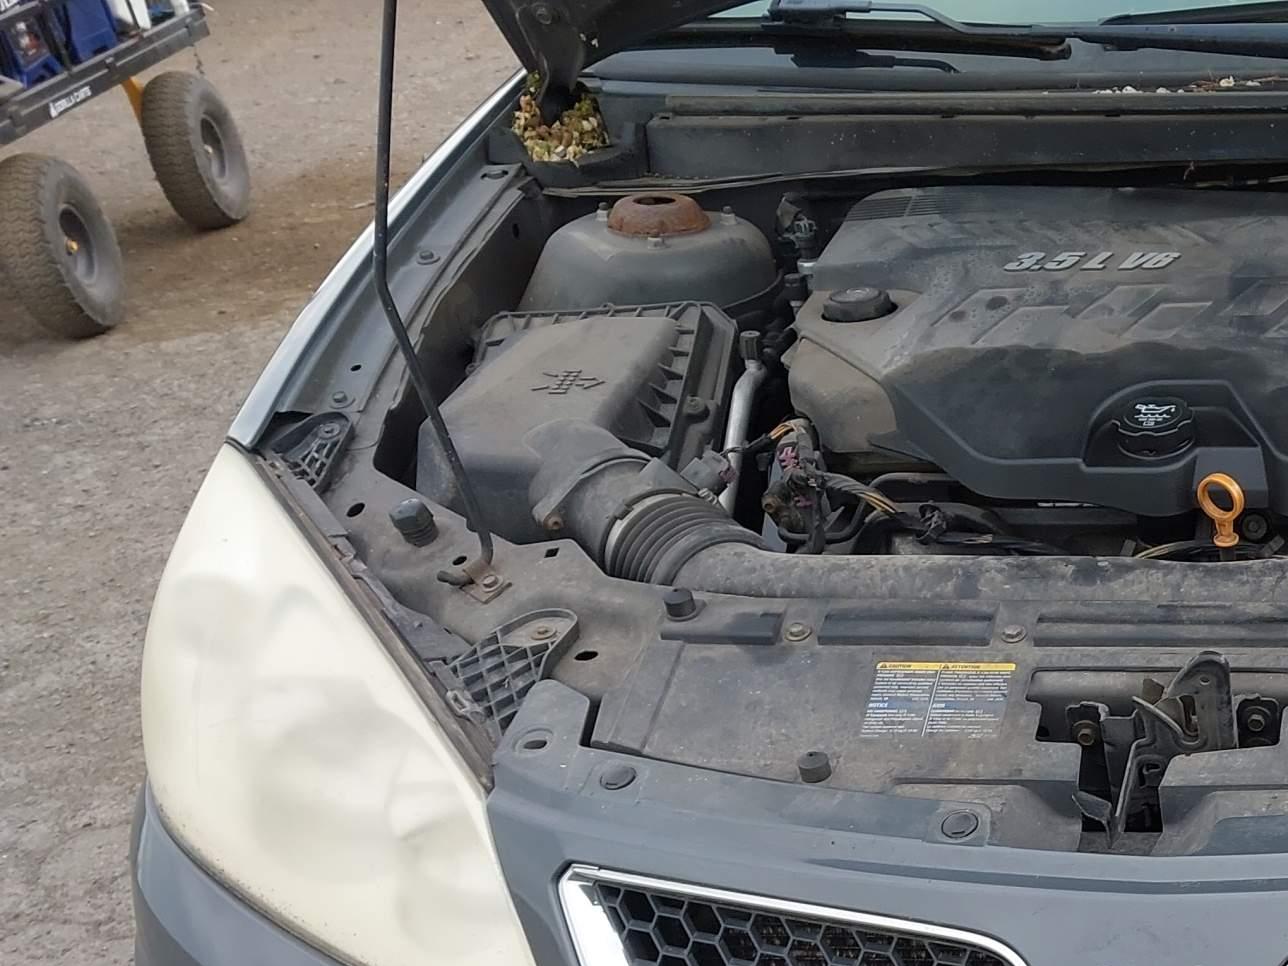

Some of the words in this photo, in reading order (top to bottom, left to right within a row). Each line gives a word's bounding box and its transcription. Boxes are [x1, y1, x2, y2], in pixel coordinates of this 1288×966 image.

[1003, 251, 1086, 272] 3.5
[1080, 251, 1114, 271] L
[1117, 251, 1182, 271] V6
